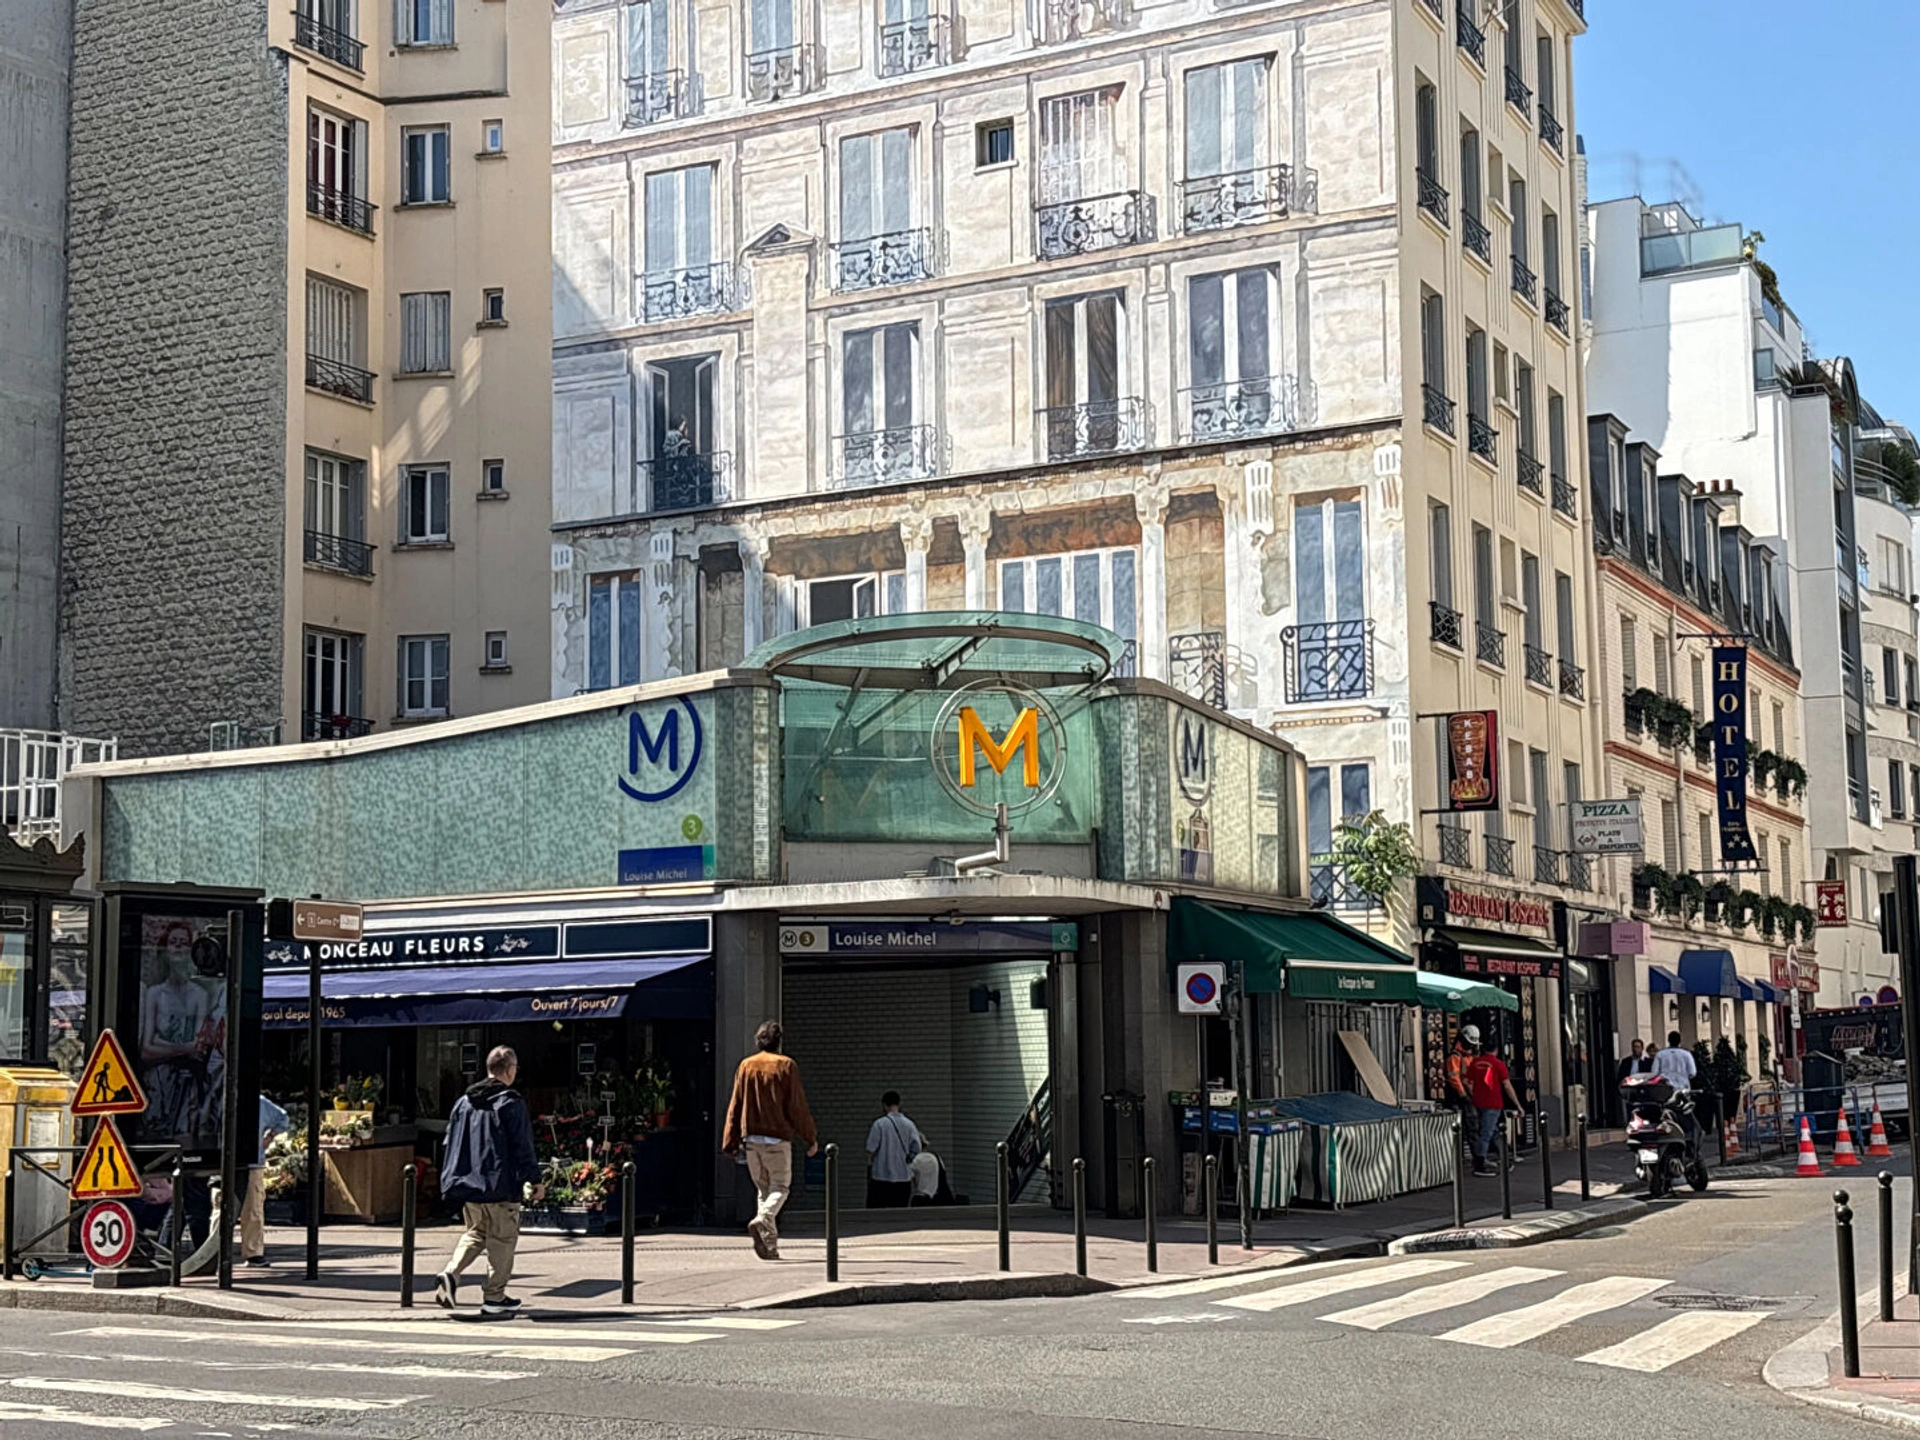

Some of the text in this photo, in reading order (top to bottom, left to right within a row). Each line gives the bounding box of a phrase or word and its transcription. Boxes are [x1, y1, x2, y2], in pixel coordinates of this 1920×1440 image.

[629, 708, 679, 776] M
[1717, 661, 1740, 811] HOTEL
[958, 706, 1040, 788] M
[1463, 719, 1474, 779] KEBAB
[1582, 804, 1630, 817] PIZZA
[688, 821, 697, 835] 3
[624, 868, 688, 882] Louise Michel
[1448, 889, 1504, 921] RESTAURANT
[405, 936, 485, 955] FLEURS
[803, 934, 811, 945] 3
[835, 931, 882, 946] Louise
[887, 931, 937, 946] Michel
[285, 1006, 310, 1022] depu
[320, 1006, 346, 1019] 1965
[531, 998, 568, 1011] Ouvert
[94, 1218, 123, 1248] 30
